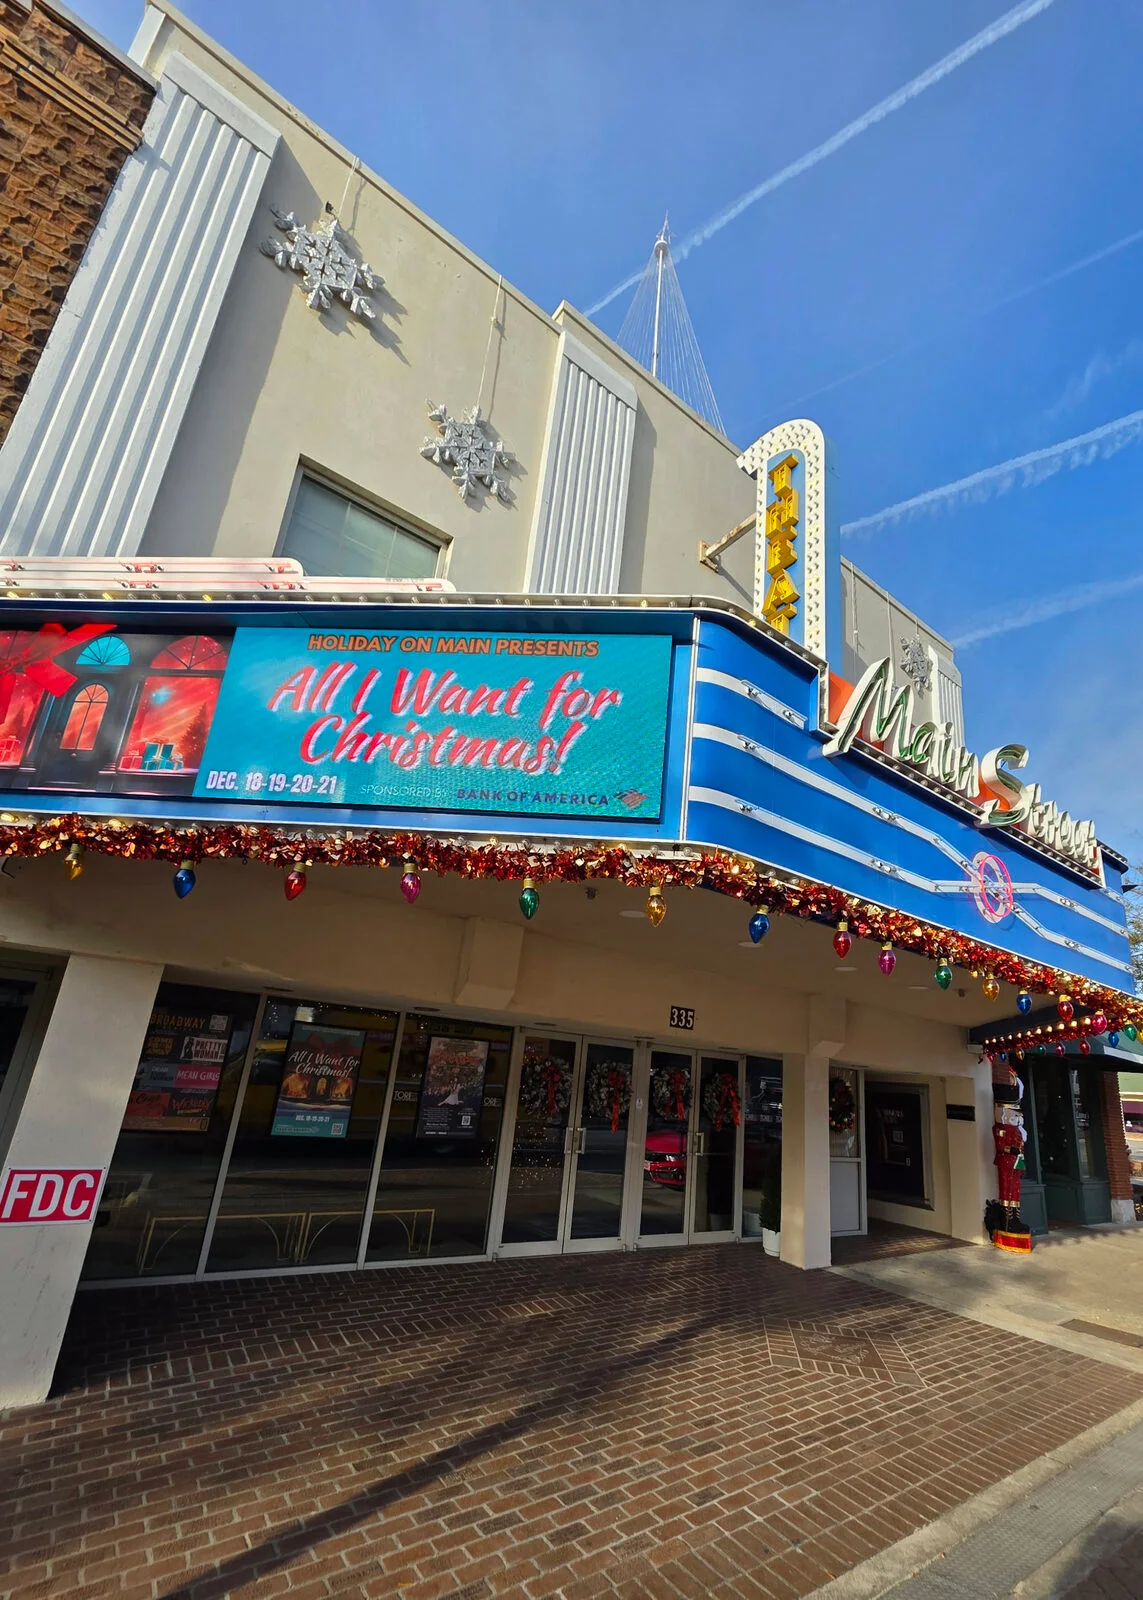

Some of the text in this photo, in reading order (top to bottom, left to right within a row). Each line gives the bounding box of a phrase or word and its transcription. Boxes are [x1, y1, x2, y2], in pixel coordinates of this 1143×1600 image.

[307, 634, 600, 658] HOLIDAY ON MAIN PRESENTS
[267, 659, 622, 732] All I Want for
[299, 710, 588, 775] Christmas!
[206, 771, 337, 794] DEC. 18-19-20-21
[822, 657, 1106, 889] Main Street
[361, 785, 431, 797] SPONSORED
[457, 789, 502, 801] BANK
[506, 791, 527, 802] OF
[531, 792, 609, 806] AMERICA
[150, 1013, 205, 1029] BROADWAY
[670, 1008, 694, 1028] 335
[193, 1049, 219, 1059] WOMAN
[195, 1039, 222, 1050] PRETTY
[288, 1049, 360, 1069] All I Want for
[176, 1070, 198, 1081] MEAN
[199, 1071, 221, 1082] GIRLS
[295, 1062, 354, 1079] Christmas!
[1, 1173, 95, 1219] FDC
